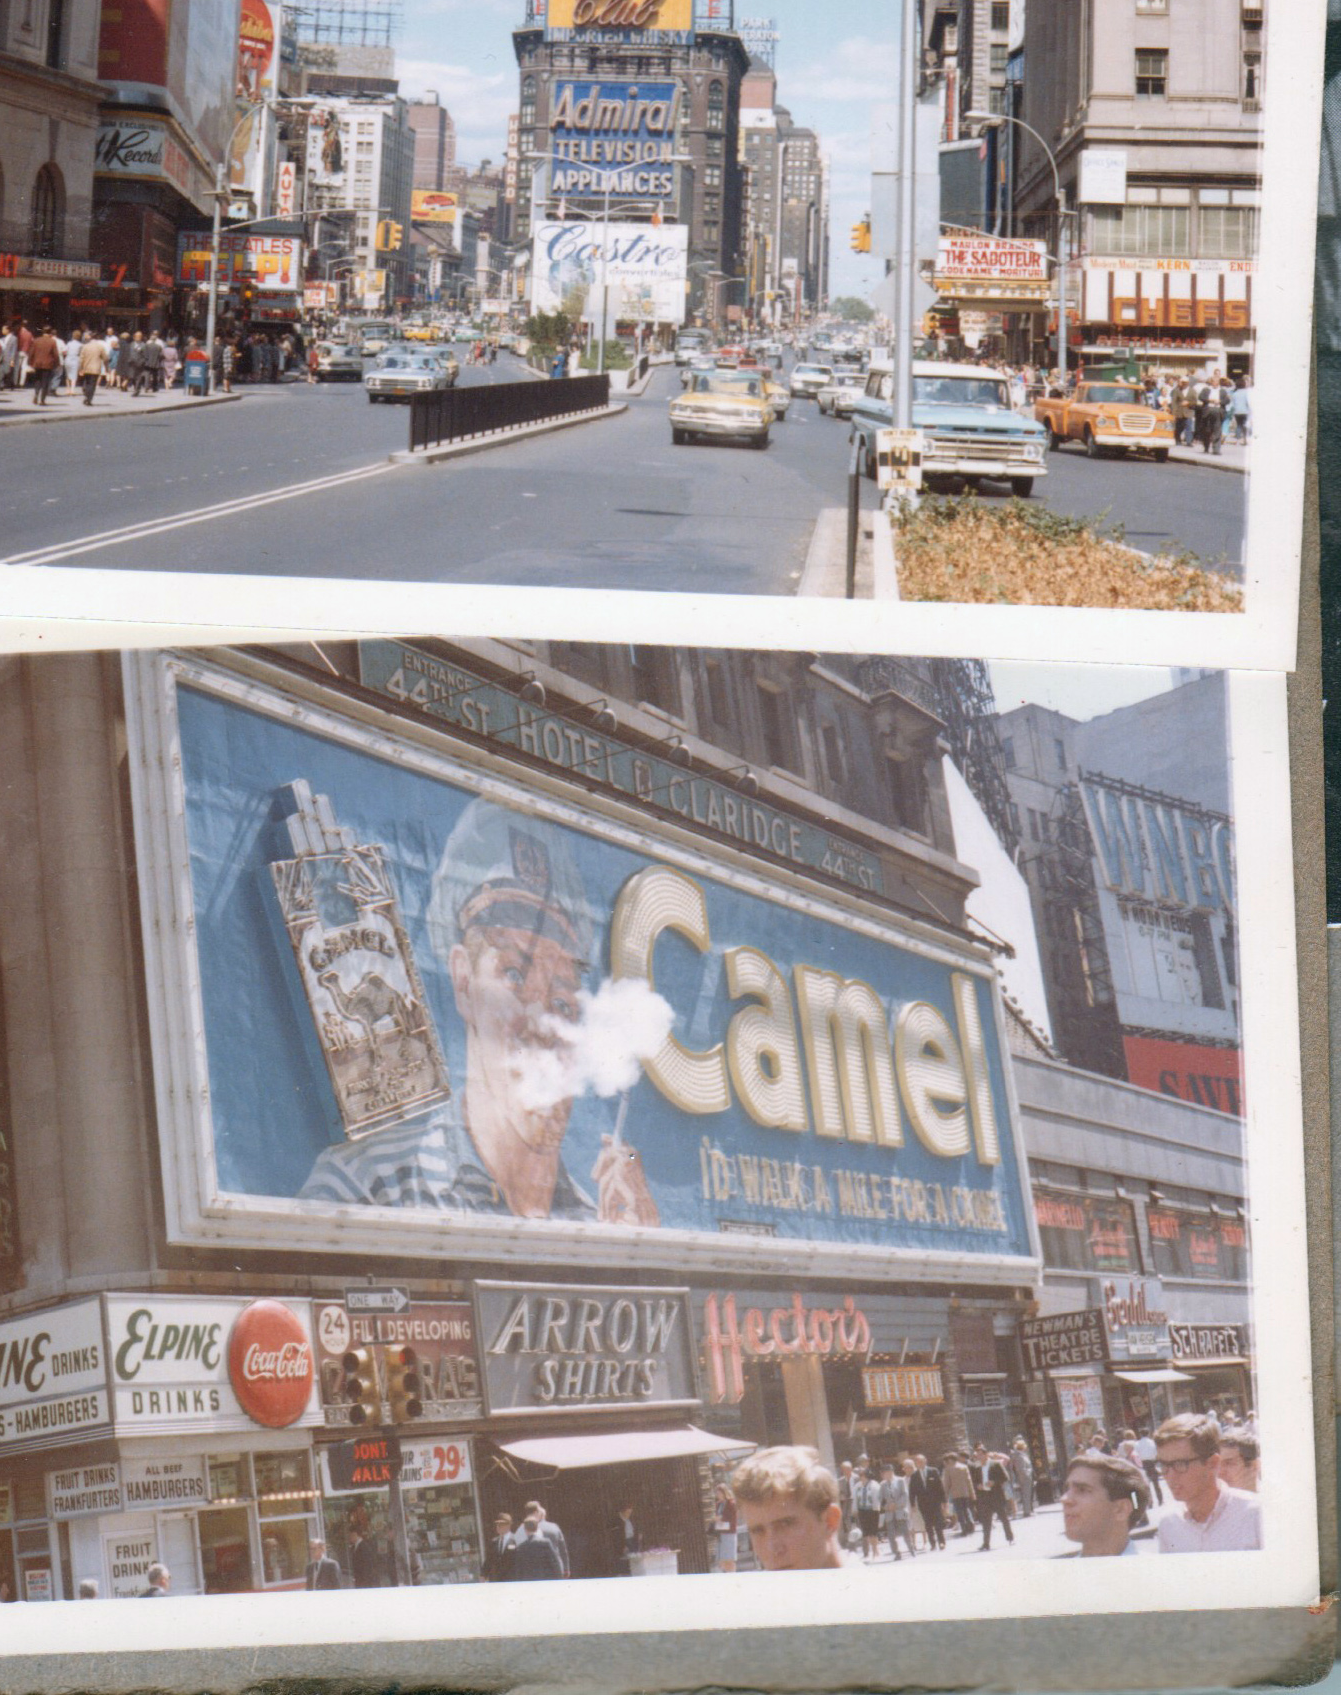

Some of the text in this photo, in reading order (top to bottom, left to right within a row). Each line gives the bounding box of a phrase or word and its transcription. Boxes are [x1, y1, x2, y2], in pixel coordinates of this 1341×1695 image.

[630, 30, 689, 44] WHISKY
[550, 83, 681, 131] Admiral
[556, 140, 673, 163] TELEVISION
[552, 170, 673, 194] APPLIANCES
[219, 235, 294, 254] BEATLES
[538, 225, 685, 266] Castro
[950, 241, 990, 249] MARLON
[944, 250, 1042, 268] THE SABOTEUR
[1157, 260, 1191, 270] KERN
[1113, 297, 1249, 328] CHEFS
[1096, 335, 1206, 349] RESTAURANT
[404, 655, 472, 691] ENTRANCE
[460, 697, 490, 737] ST
[519, 705, 805, 865] HOTEL CLARIDGE
[858, 865, 875, 891] ST
[310, 927, 396, 972] CAMEL
[611, 866, 1002, 1167] Camel
[814, 1165, 832, 1212] A
[835, 1169, 888, 1220] MILE
[890, 1176, 930, 1225] FOR
[932, 1182, 949, 1225] A
[350, 1293, 402, 1306] ONE WAY
[323, 1312, 346, 1335] 24
[387, 1319, 472, 1341] DEVELOPING
[488, 1295, 680, 1354] ARROW
[1023, 1310, 1097, 1336] NEWMAN'S
[115, 1309, 222, 1381] ELPINE
[324, 1337, 345, 1347] HOUR
[706, 1291, 871, 1404] Hector's
[1022, 1327, 1102, 1368] THEATRE
[51, 1346, 99, 1377] DRINKS
[539, 1358, 657, 1403] SHIRTS
[14, 1395, 99, 1434] HAMBURGERS
[132, 1389, 220, 1415] DRINKS
[55, 1466, 117, 1491] FRUIT DRINKS
[145, 1463, 183, 1476] ALL BEEF
[54, 1488, 121, 1513] FRANKFURTERS
[126, 1476, 205, 1502] HAMBURGERS
[115, 1541, 152, 1560] FRUIT
